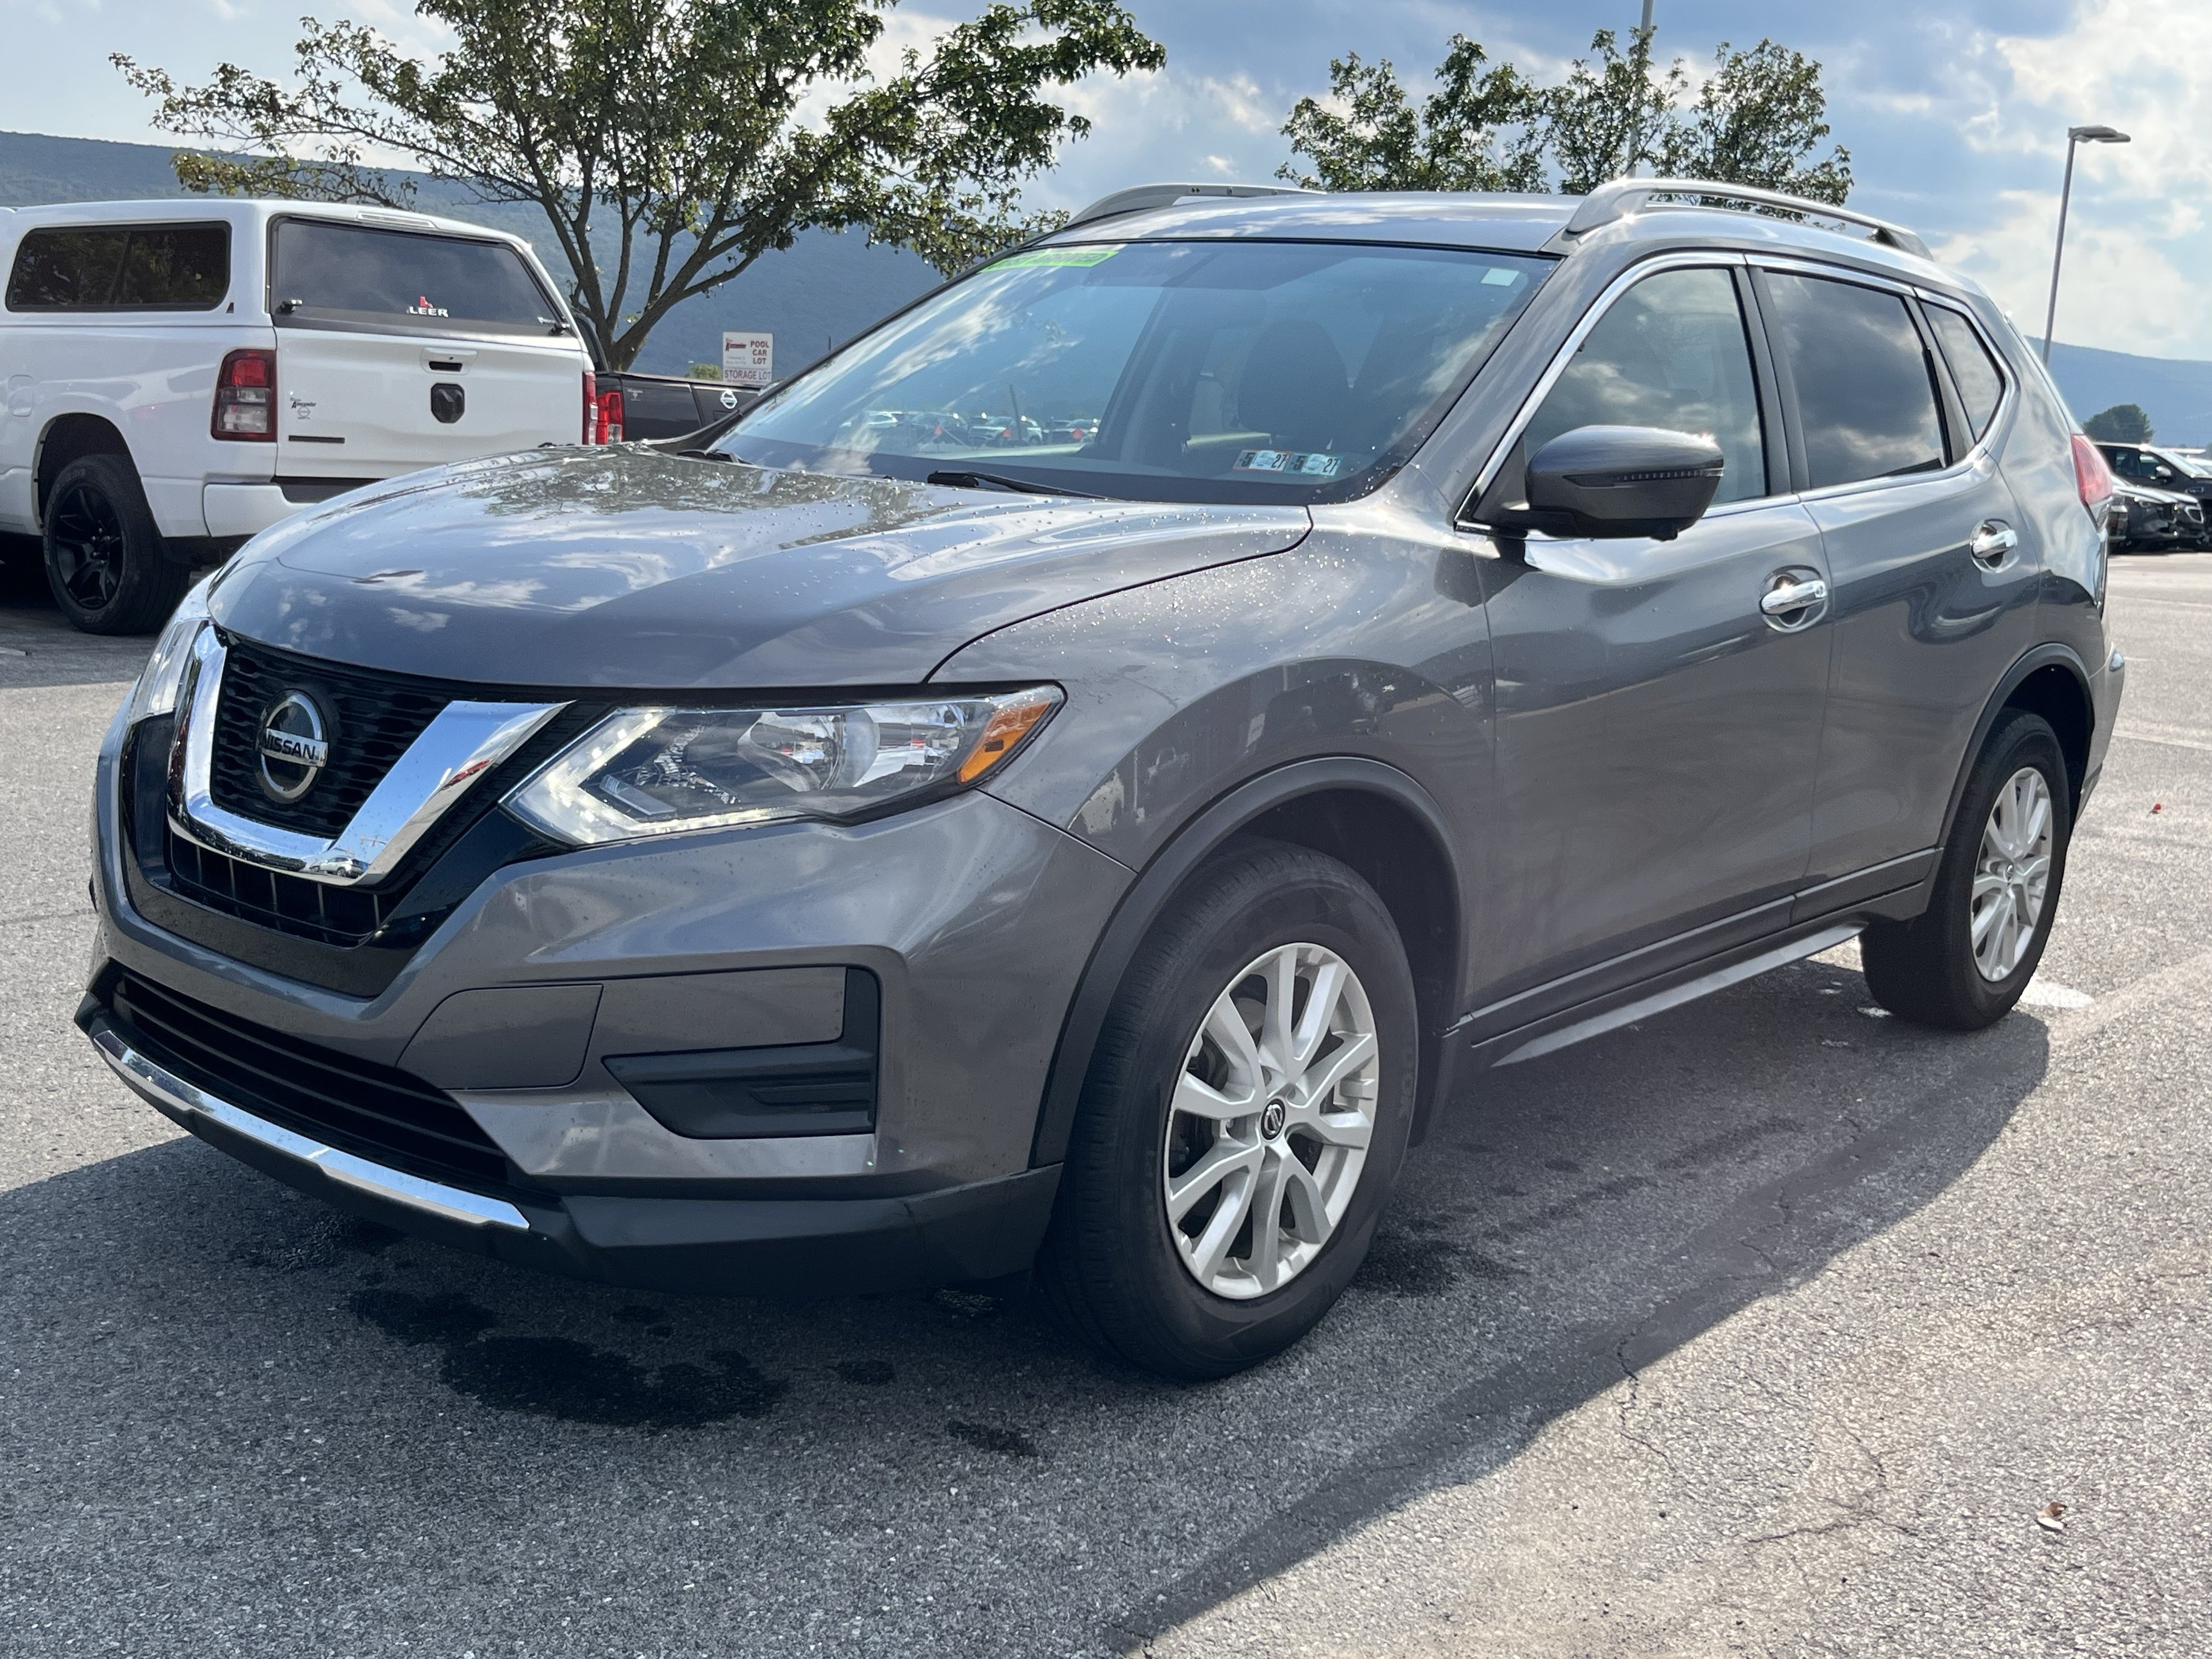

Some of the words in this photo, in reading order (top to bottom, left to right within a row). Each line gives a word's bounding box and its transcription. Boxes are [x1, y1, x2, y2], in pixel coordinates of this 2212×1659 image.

[409, 306, 449, 318] LEER
[724, 370, 757, 379] STORAGE
[759, 371, 771, 380] LOT
[263, 733, 315, 760] NISSAN
